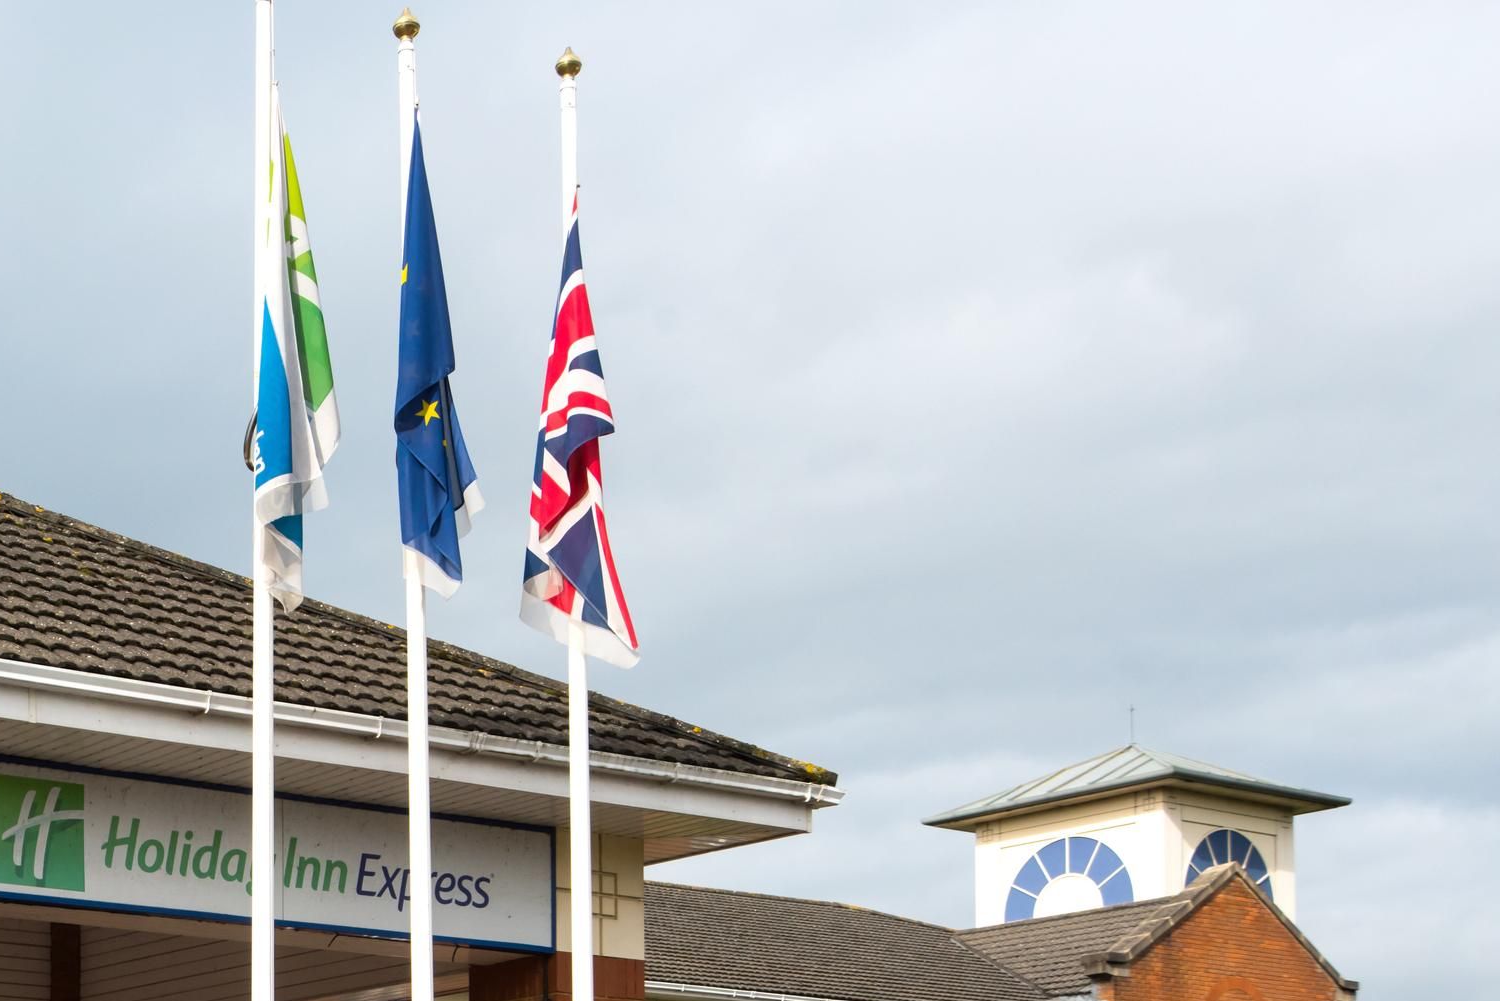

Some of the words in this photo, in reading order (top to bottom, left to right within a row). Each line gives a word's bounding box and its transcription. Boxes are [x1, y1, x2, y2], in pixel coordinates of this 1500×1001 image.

[101, 815, 276, 897] Holida
[283, 836, 348, 894] Inn
[356, 852, 491, 913] Expess
